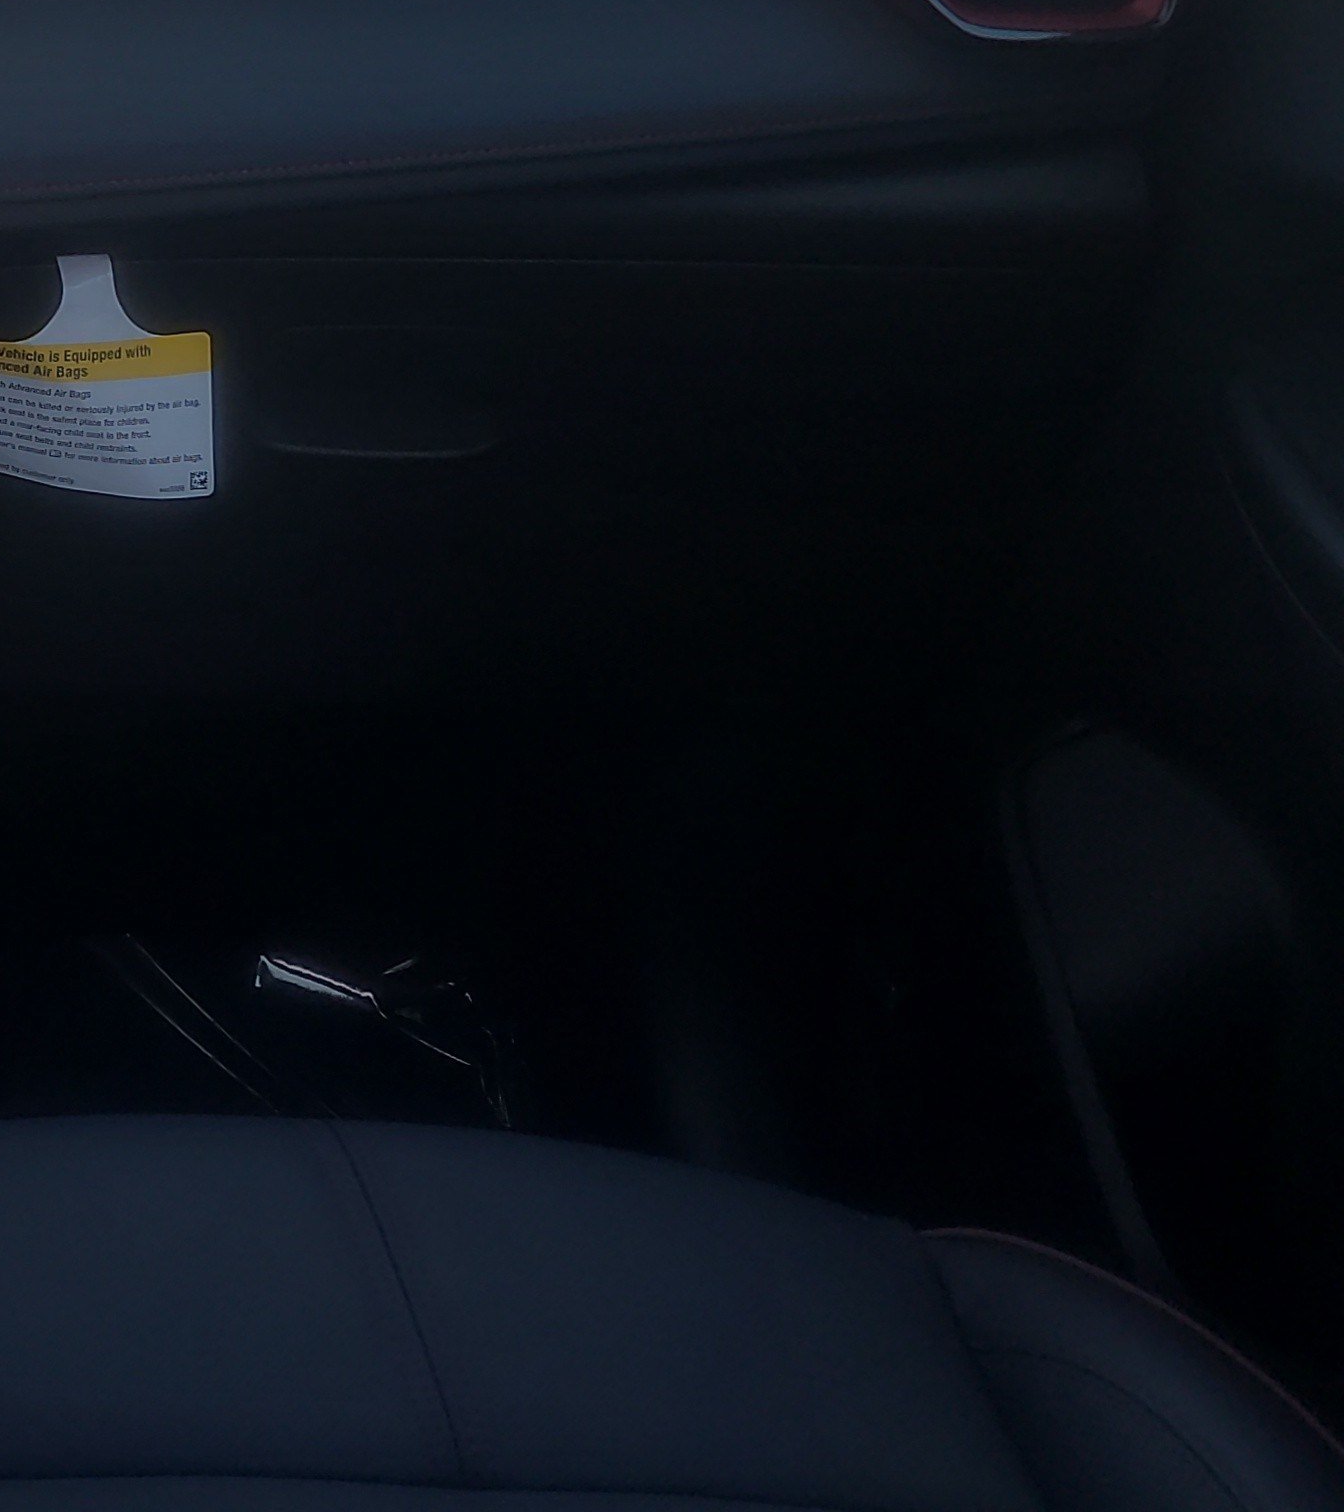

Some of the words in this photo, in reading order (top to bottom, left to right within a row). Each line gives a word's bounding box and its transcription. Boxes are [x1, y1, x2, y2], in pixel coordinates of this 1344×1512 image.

[49, 350, 60, 362] is
[64, 347, 121, 363] Equipped
[125, 345, 151, 358] with
[33, 366, 52, 378] Air
[56, 366, 89, 379] Bags
[8, 382, 52, 396] Advanced
[53, 389, 67, 397] Air
[69, 390, 91, 400] Bags
[8, 397, 22, 405] can
[39, 402, 61, 411] killed
[116, 404, 143, 414] injured
[146, 403, 155, 411] by
[116, 432, 129, 440] the
